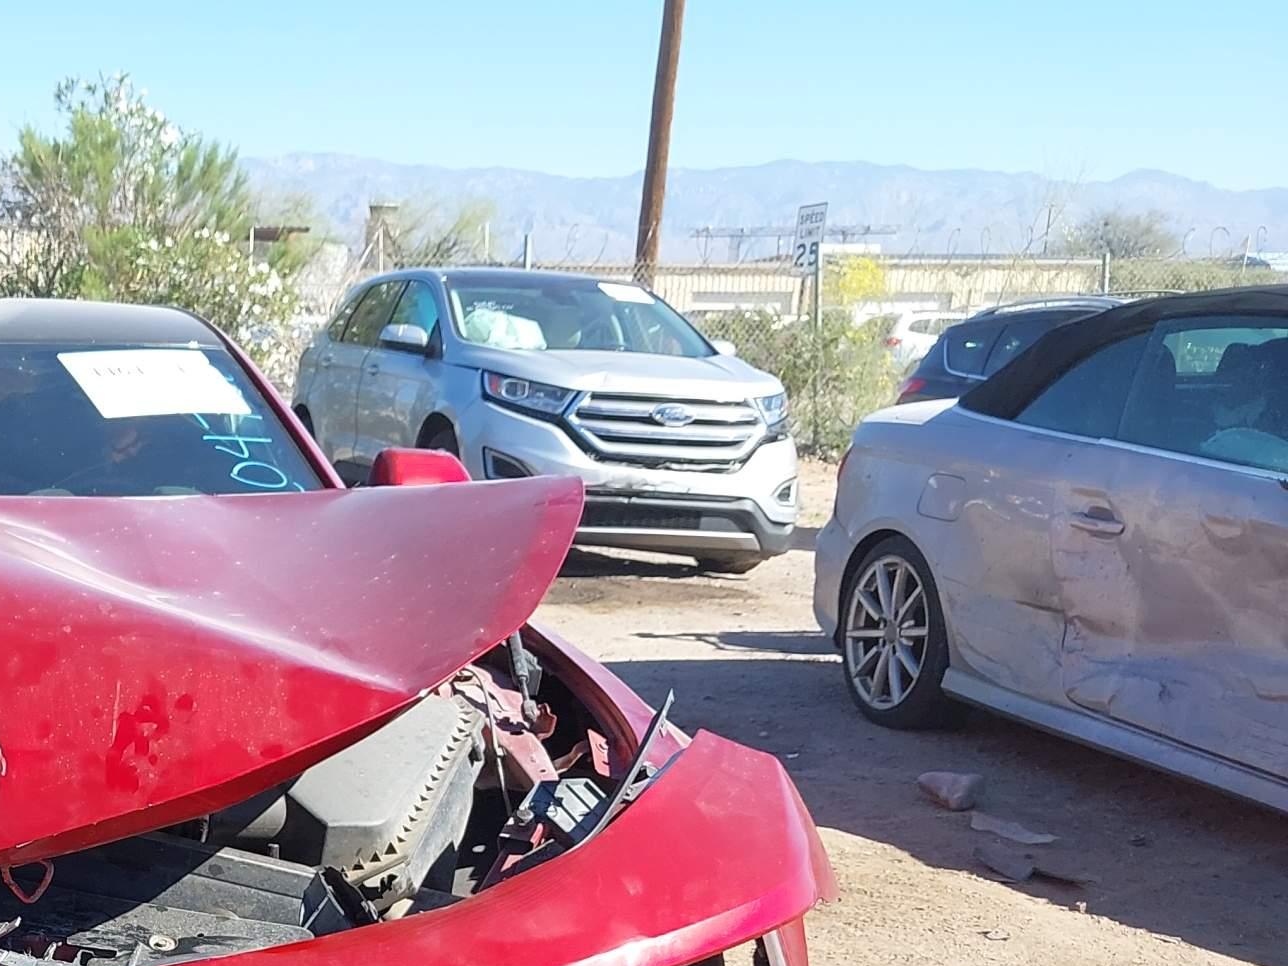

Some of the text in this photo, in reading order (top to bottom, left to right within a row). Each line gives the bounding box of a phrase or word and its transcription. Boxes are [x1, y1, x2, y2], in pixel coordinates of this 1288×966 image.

[799, 211, 825, 225] SPEED
[799, 226, 821, 239] LIMIT
[794, 241, 819, 267] 25
